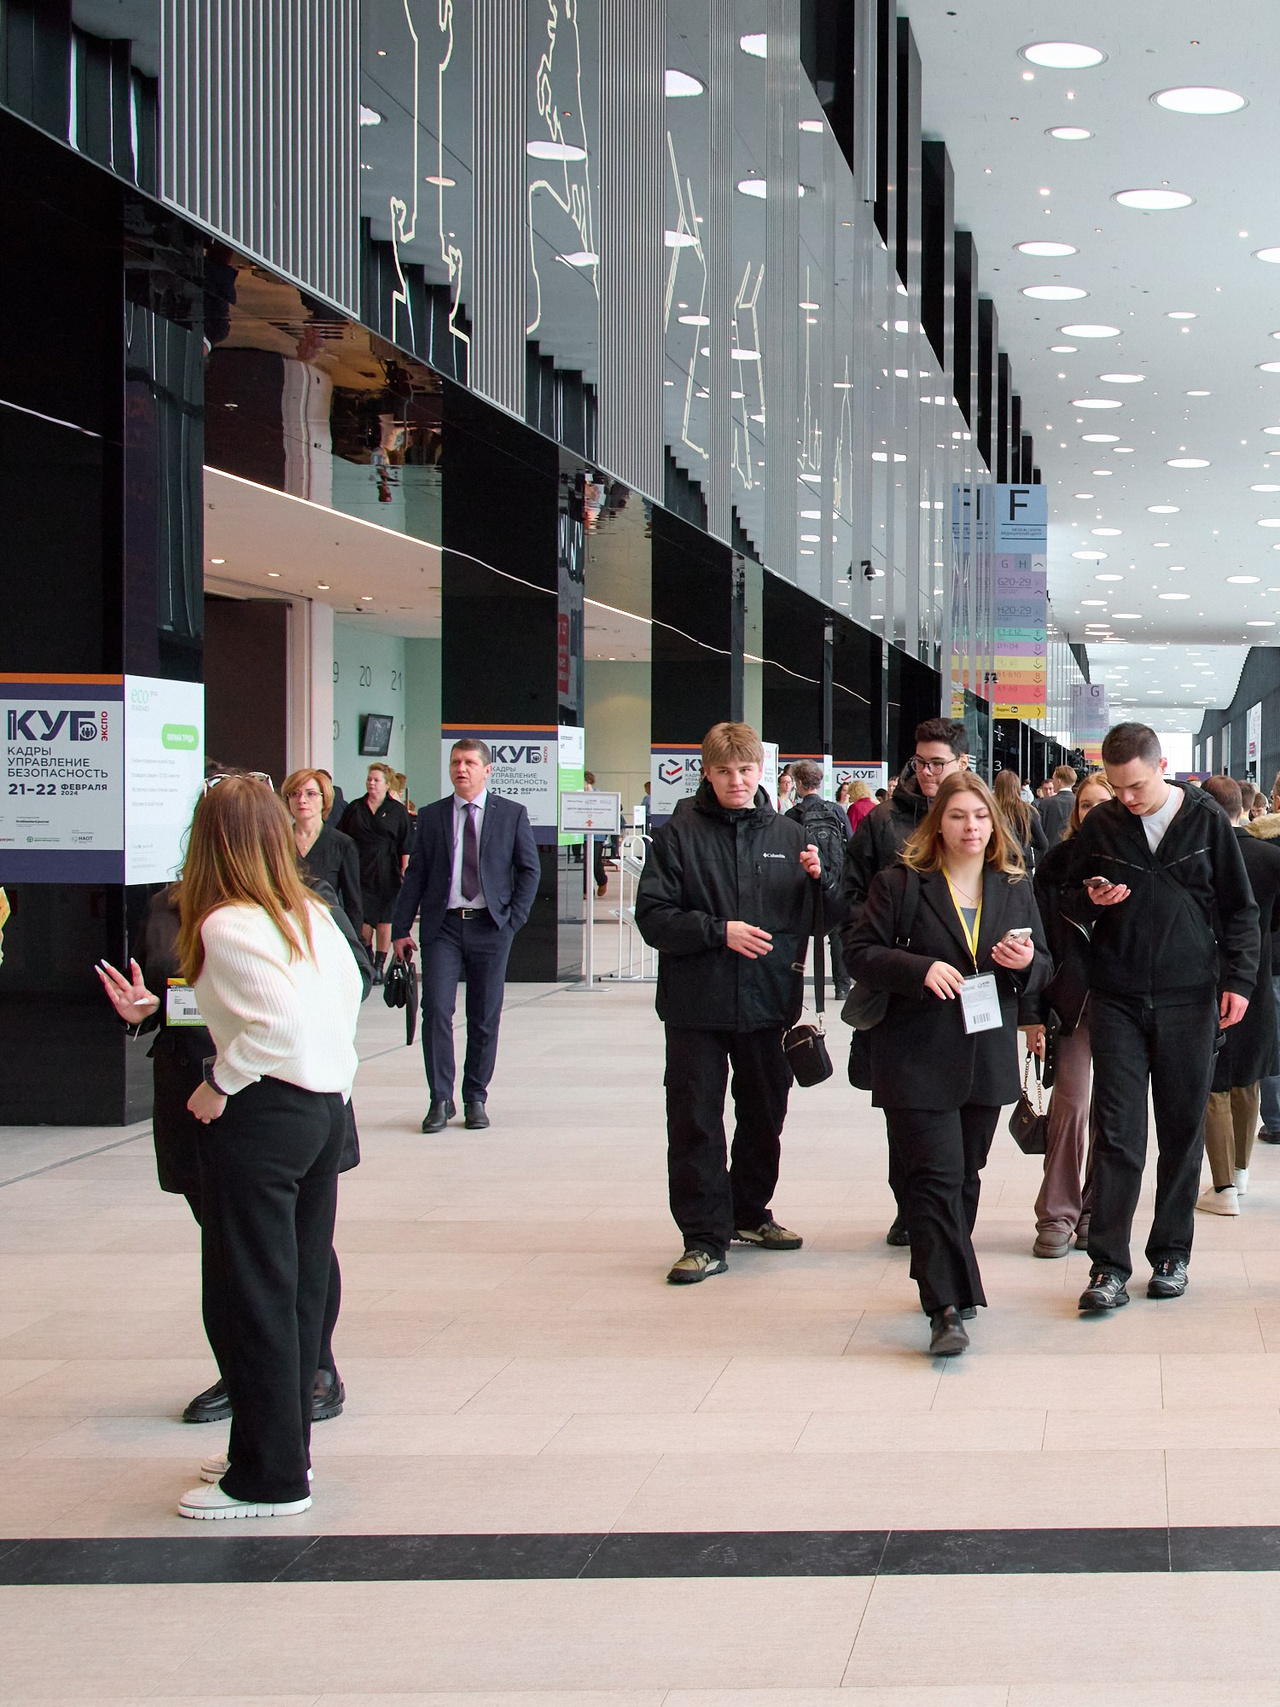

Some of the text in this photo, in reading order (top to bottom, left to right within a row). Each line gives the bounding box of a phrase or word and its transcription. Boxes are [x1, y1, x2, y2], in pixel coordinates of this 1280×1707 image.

[1010, 489, 1029, 520] F
[1001, 559, 1027, 569] G H
[997, 577, 1032, 587] G20-29
[997, 606, 1032, 615] H20-29
[359, 665, 372, 687] 20
[1090, 684, 1100, 698] G
[7, 709, 109, 742] КУБ ЭКСПО
[7, 746, 52, 757] КАДРЫ
[491, 745, 542, 764] КУБ
[7, 758, 90, 767] УПРАВЛЕНИЕ
[7, 768, 109, 778] БЕЗОПАСНОСТЬ
